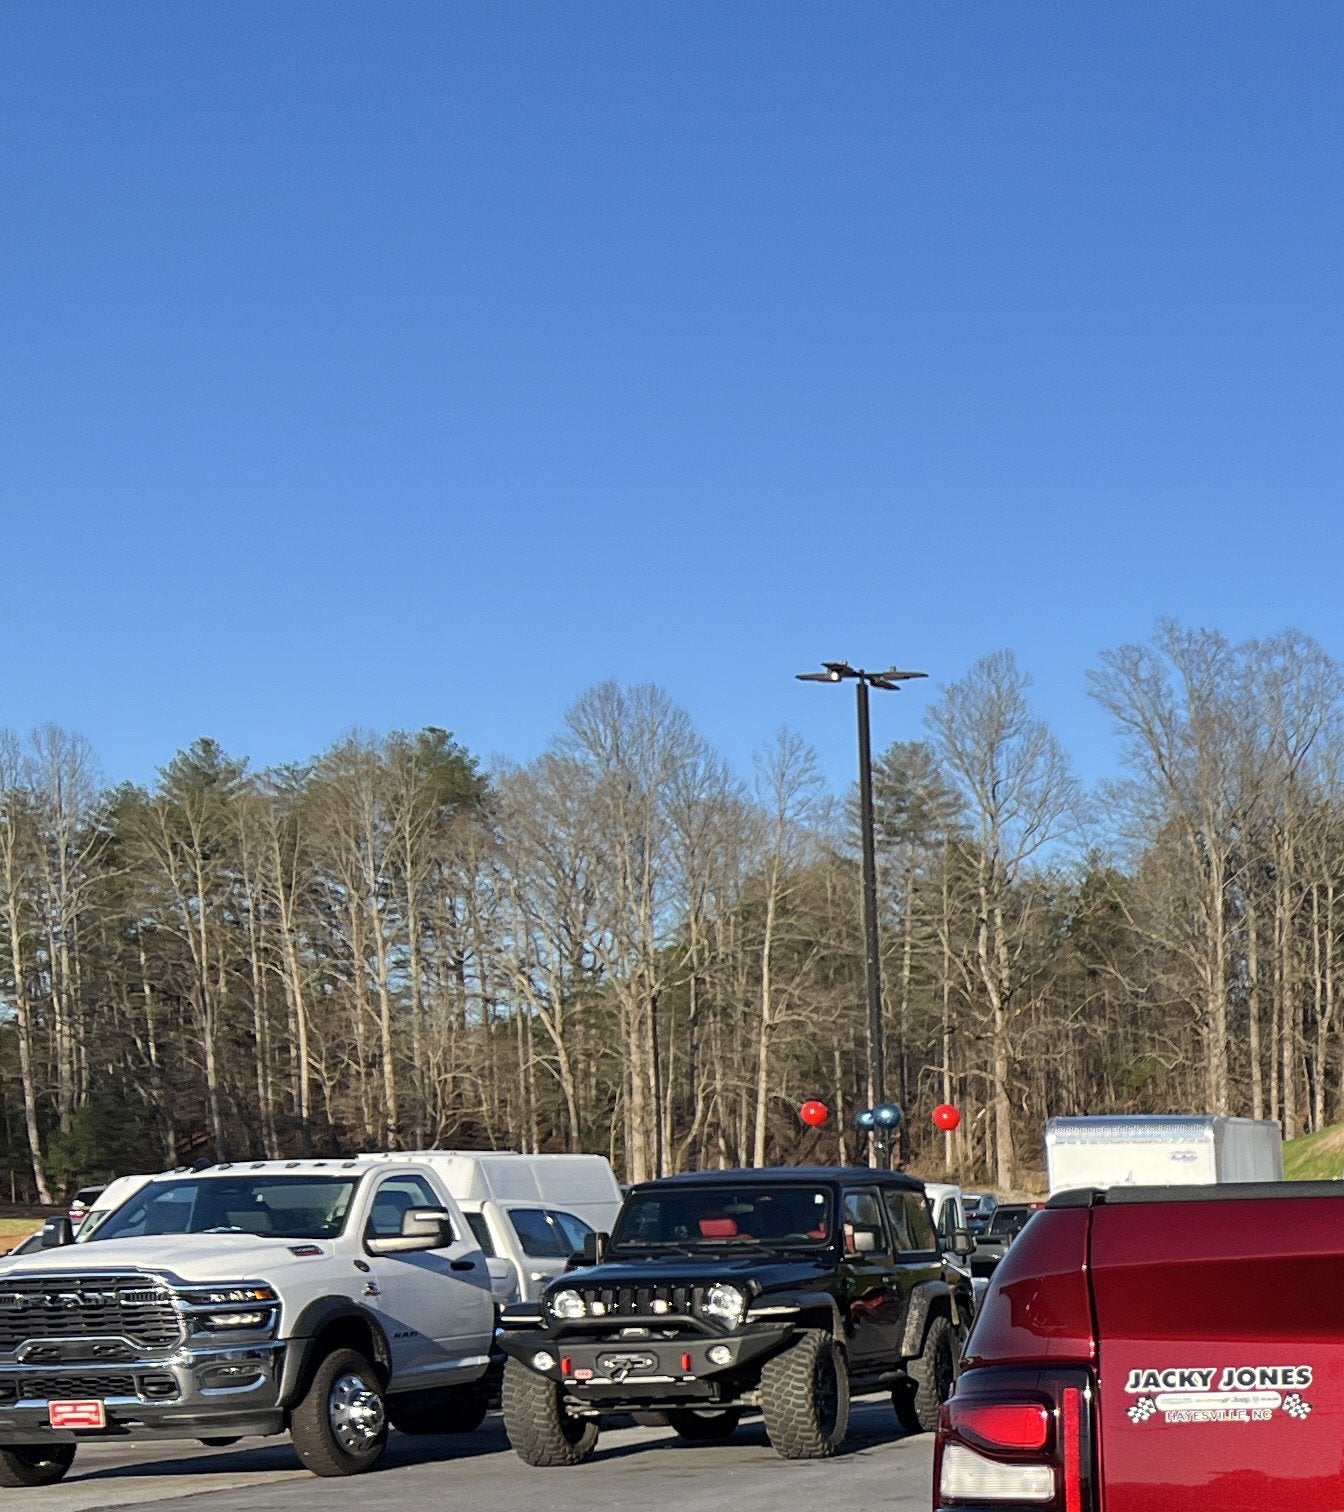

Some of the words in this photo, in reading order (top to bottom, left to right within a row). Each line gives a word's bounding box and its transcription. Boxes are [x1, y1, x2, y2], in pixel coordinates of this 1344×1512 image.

[1126, 1368, 1216, 1391] JACKY
[1218, 1366, 1312, 1391] JONES
[1164, 1409, 1250, 1423] HAYESVILLE,
[1252, 1408, 1273, 1421] NC
